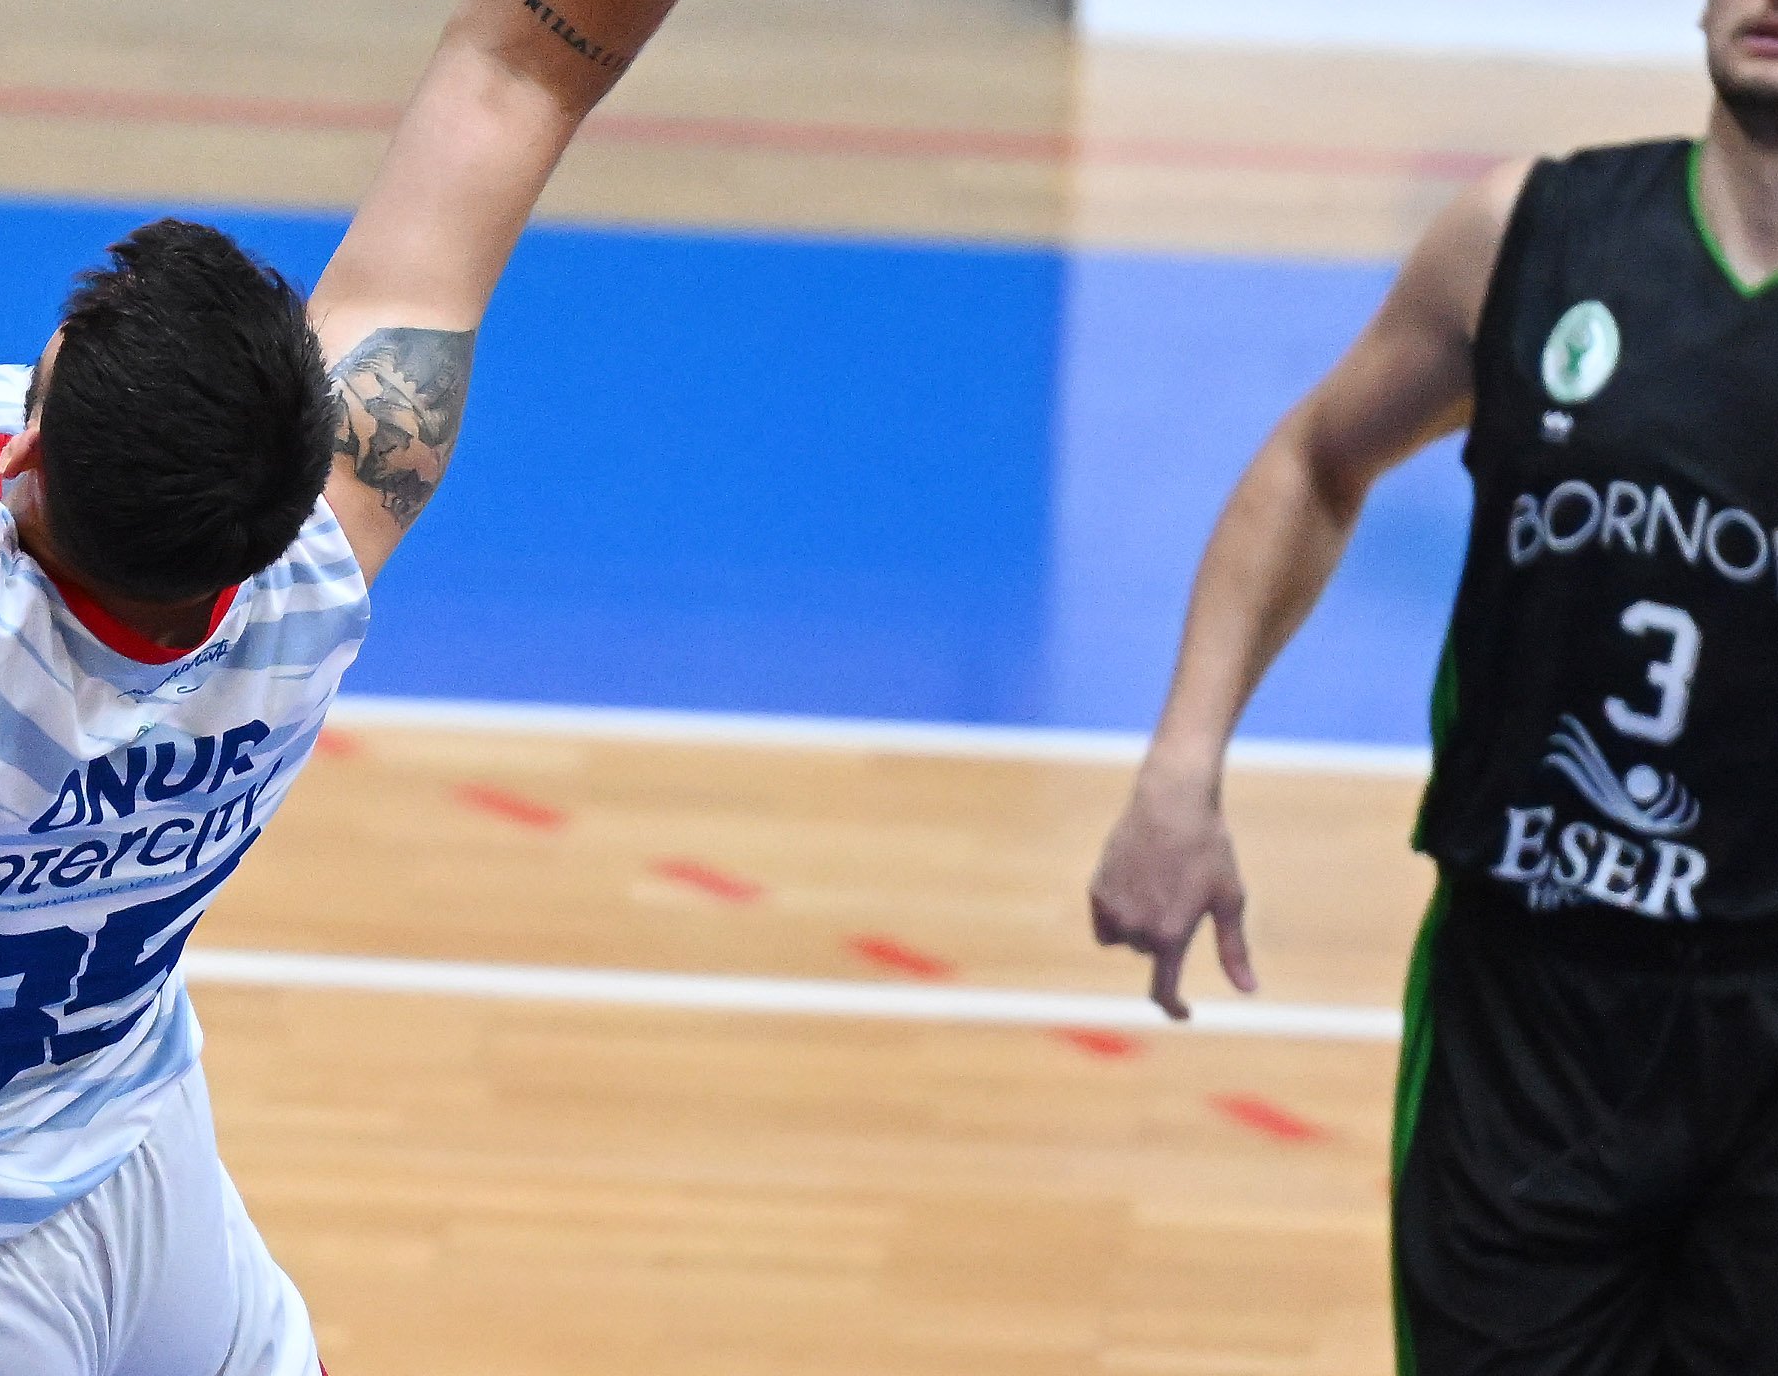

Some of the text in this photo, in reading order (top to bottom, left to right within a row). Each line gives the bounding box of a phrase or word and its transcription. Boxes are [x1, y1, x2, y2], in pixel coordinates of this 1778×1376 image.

[1509, 480, 1778, 587] BORNO
[1604, 599, 1702, 745] 3
[1489, 806, 1708, 920] ESER
